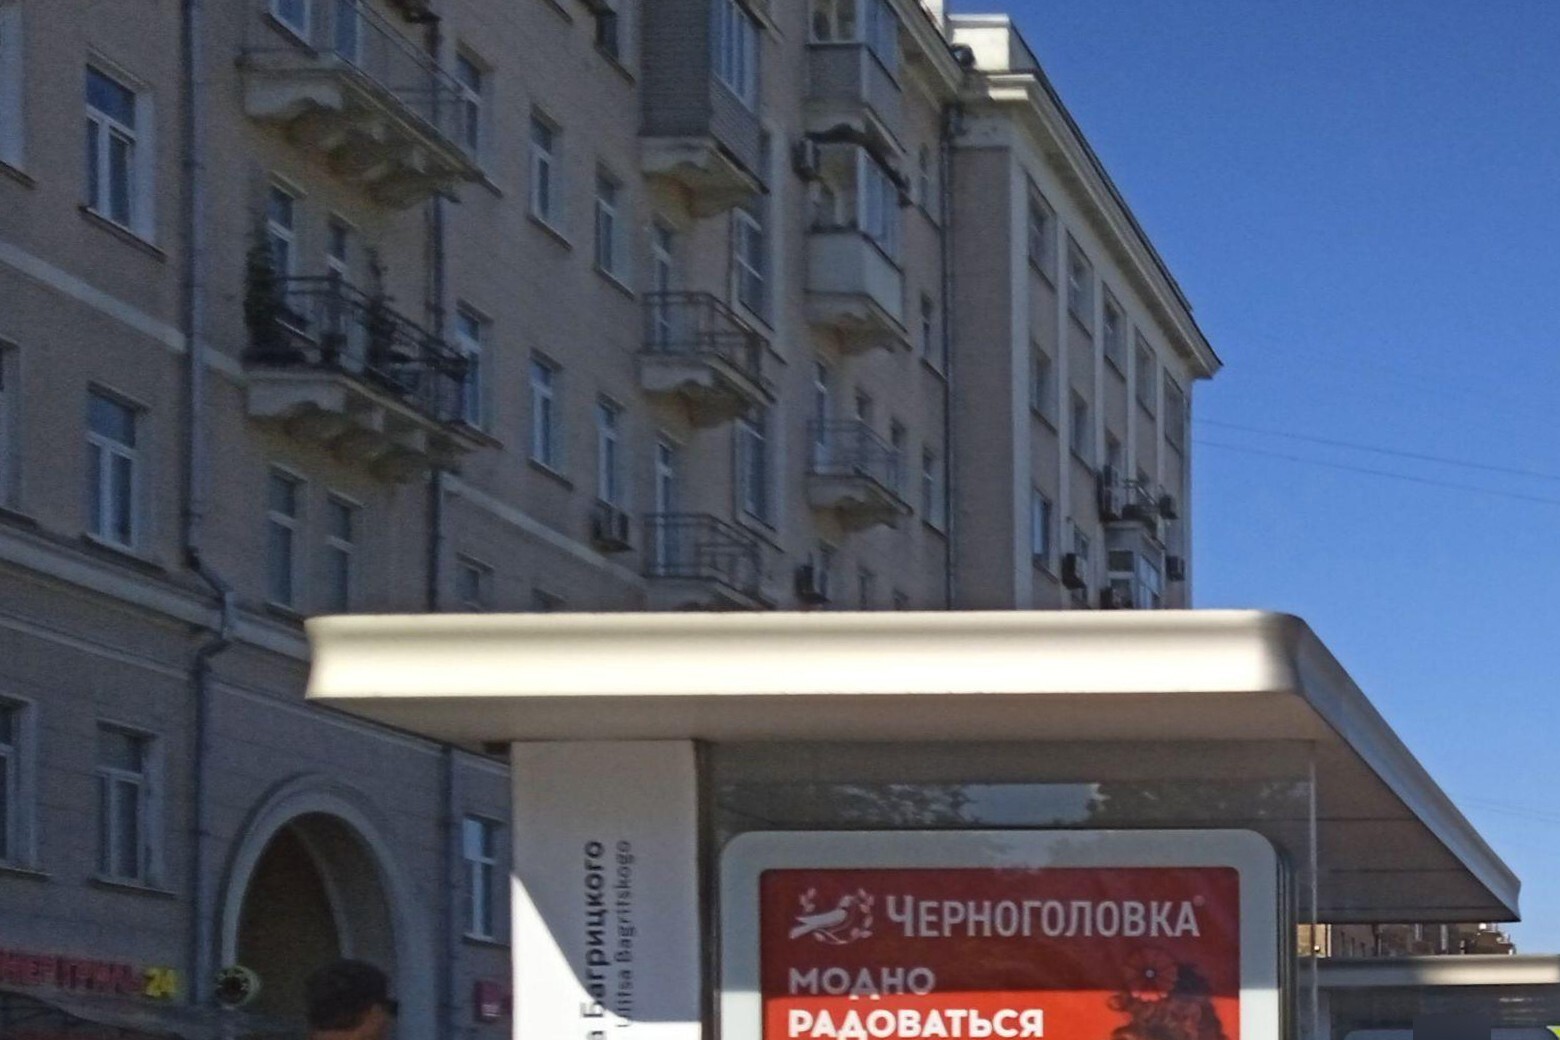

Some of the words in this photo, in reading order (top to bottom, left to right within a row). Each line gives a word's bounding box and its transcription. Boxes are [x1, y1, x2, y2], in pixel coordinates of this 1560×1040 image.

[614, 840, 636, 963] Bagritskogo
[886, 895, 1200, 938] ЧЕРНОГОЛОВКА
[580, 840, 611, 1019] Багрицкого
[788, 967, 936, 1000] МОДНО
[788, 1009, 1044, 1040] РАДОВАТЬСЯ
